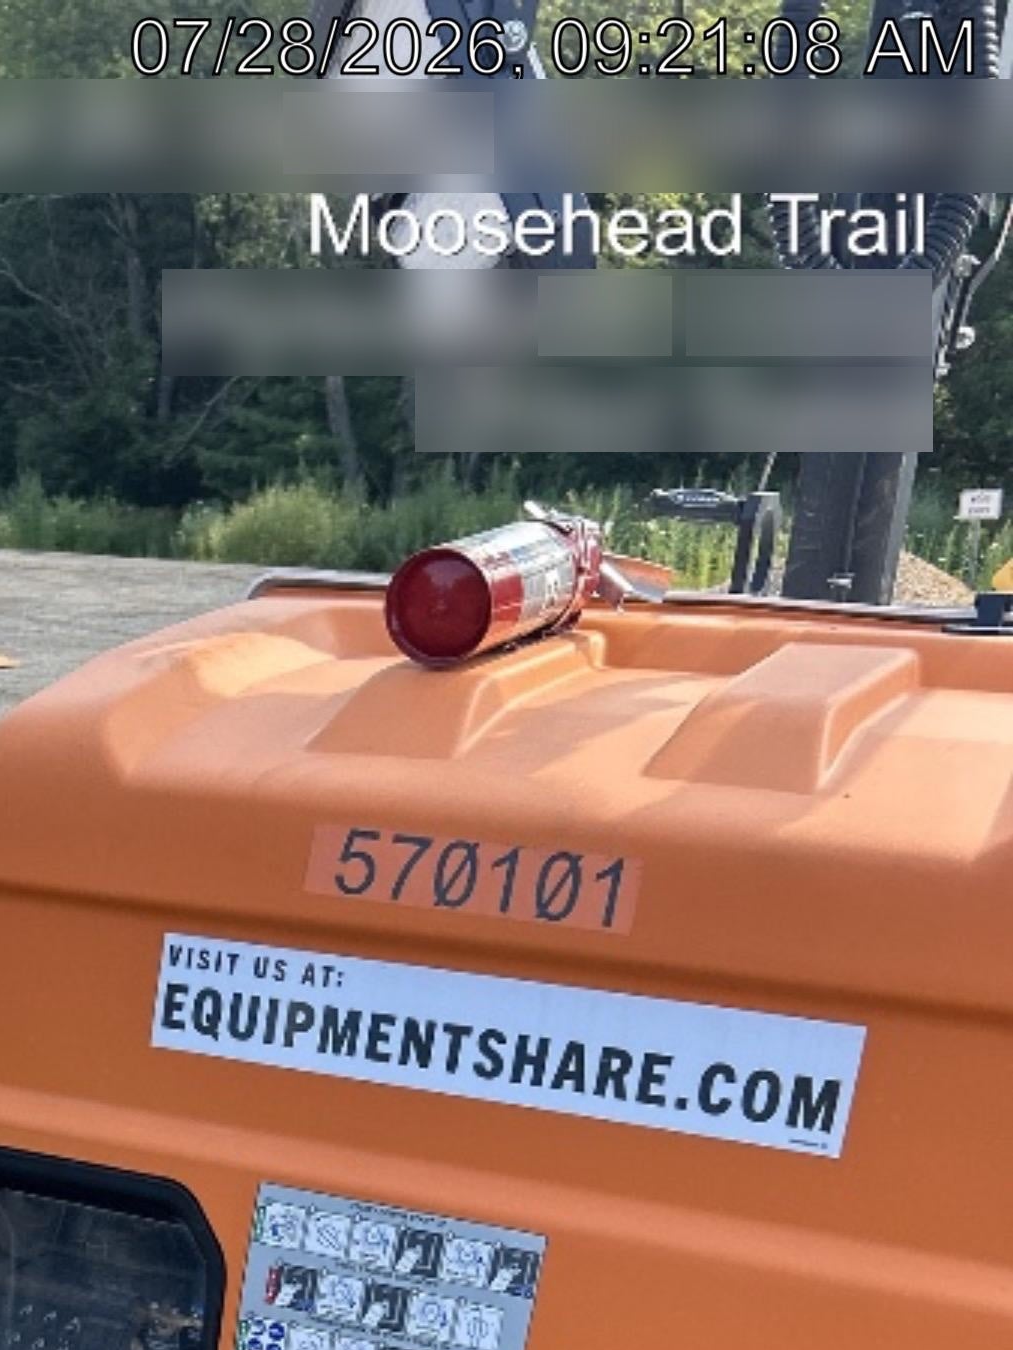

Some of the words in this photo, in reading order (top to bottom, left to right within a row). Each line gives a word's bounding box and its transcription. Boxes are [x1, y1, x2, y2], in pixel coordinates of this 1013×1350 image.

[334, 828, 625, 928] 570101
[168, 943, 241, 976] VISIT
[252, 955, 289, 982] US
[300, 963, 345, 988] AT:
[160, 982, 842, 1135] EQUIPMENTSHARE.COM
